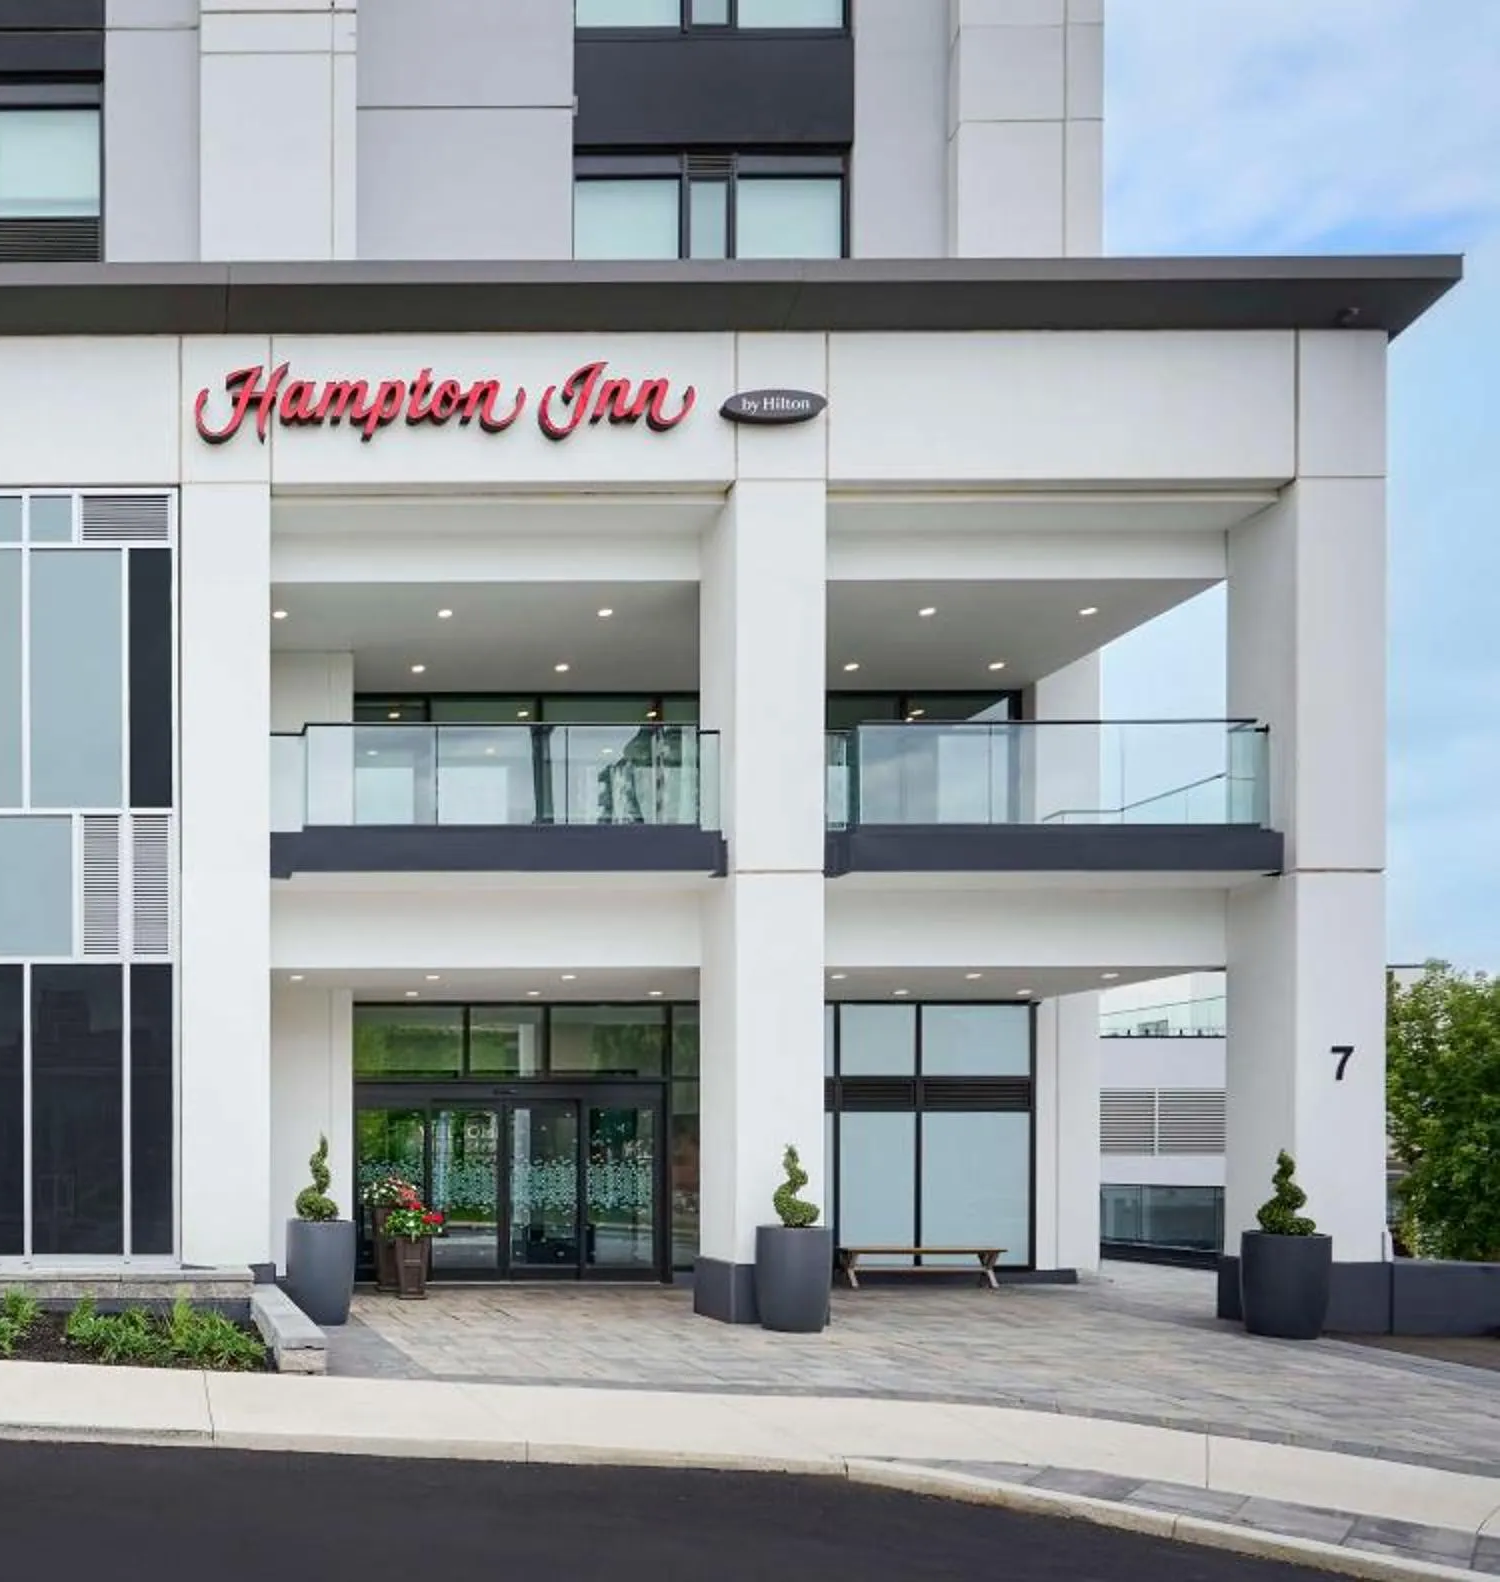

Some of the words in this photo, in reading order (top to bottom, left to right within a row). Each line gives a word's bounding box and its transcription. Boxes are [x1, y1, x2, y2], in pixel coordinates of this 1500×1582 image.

[195, 361, 526, 444] Hampton
[538, 361, 696, 441] Inn
[740, 397, 759, 415] by
[762, 396, 811, 411] Hilton
[1331, 1045, 1354, 1081] 7
